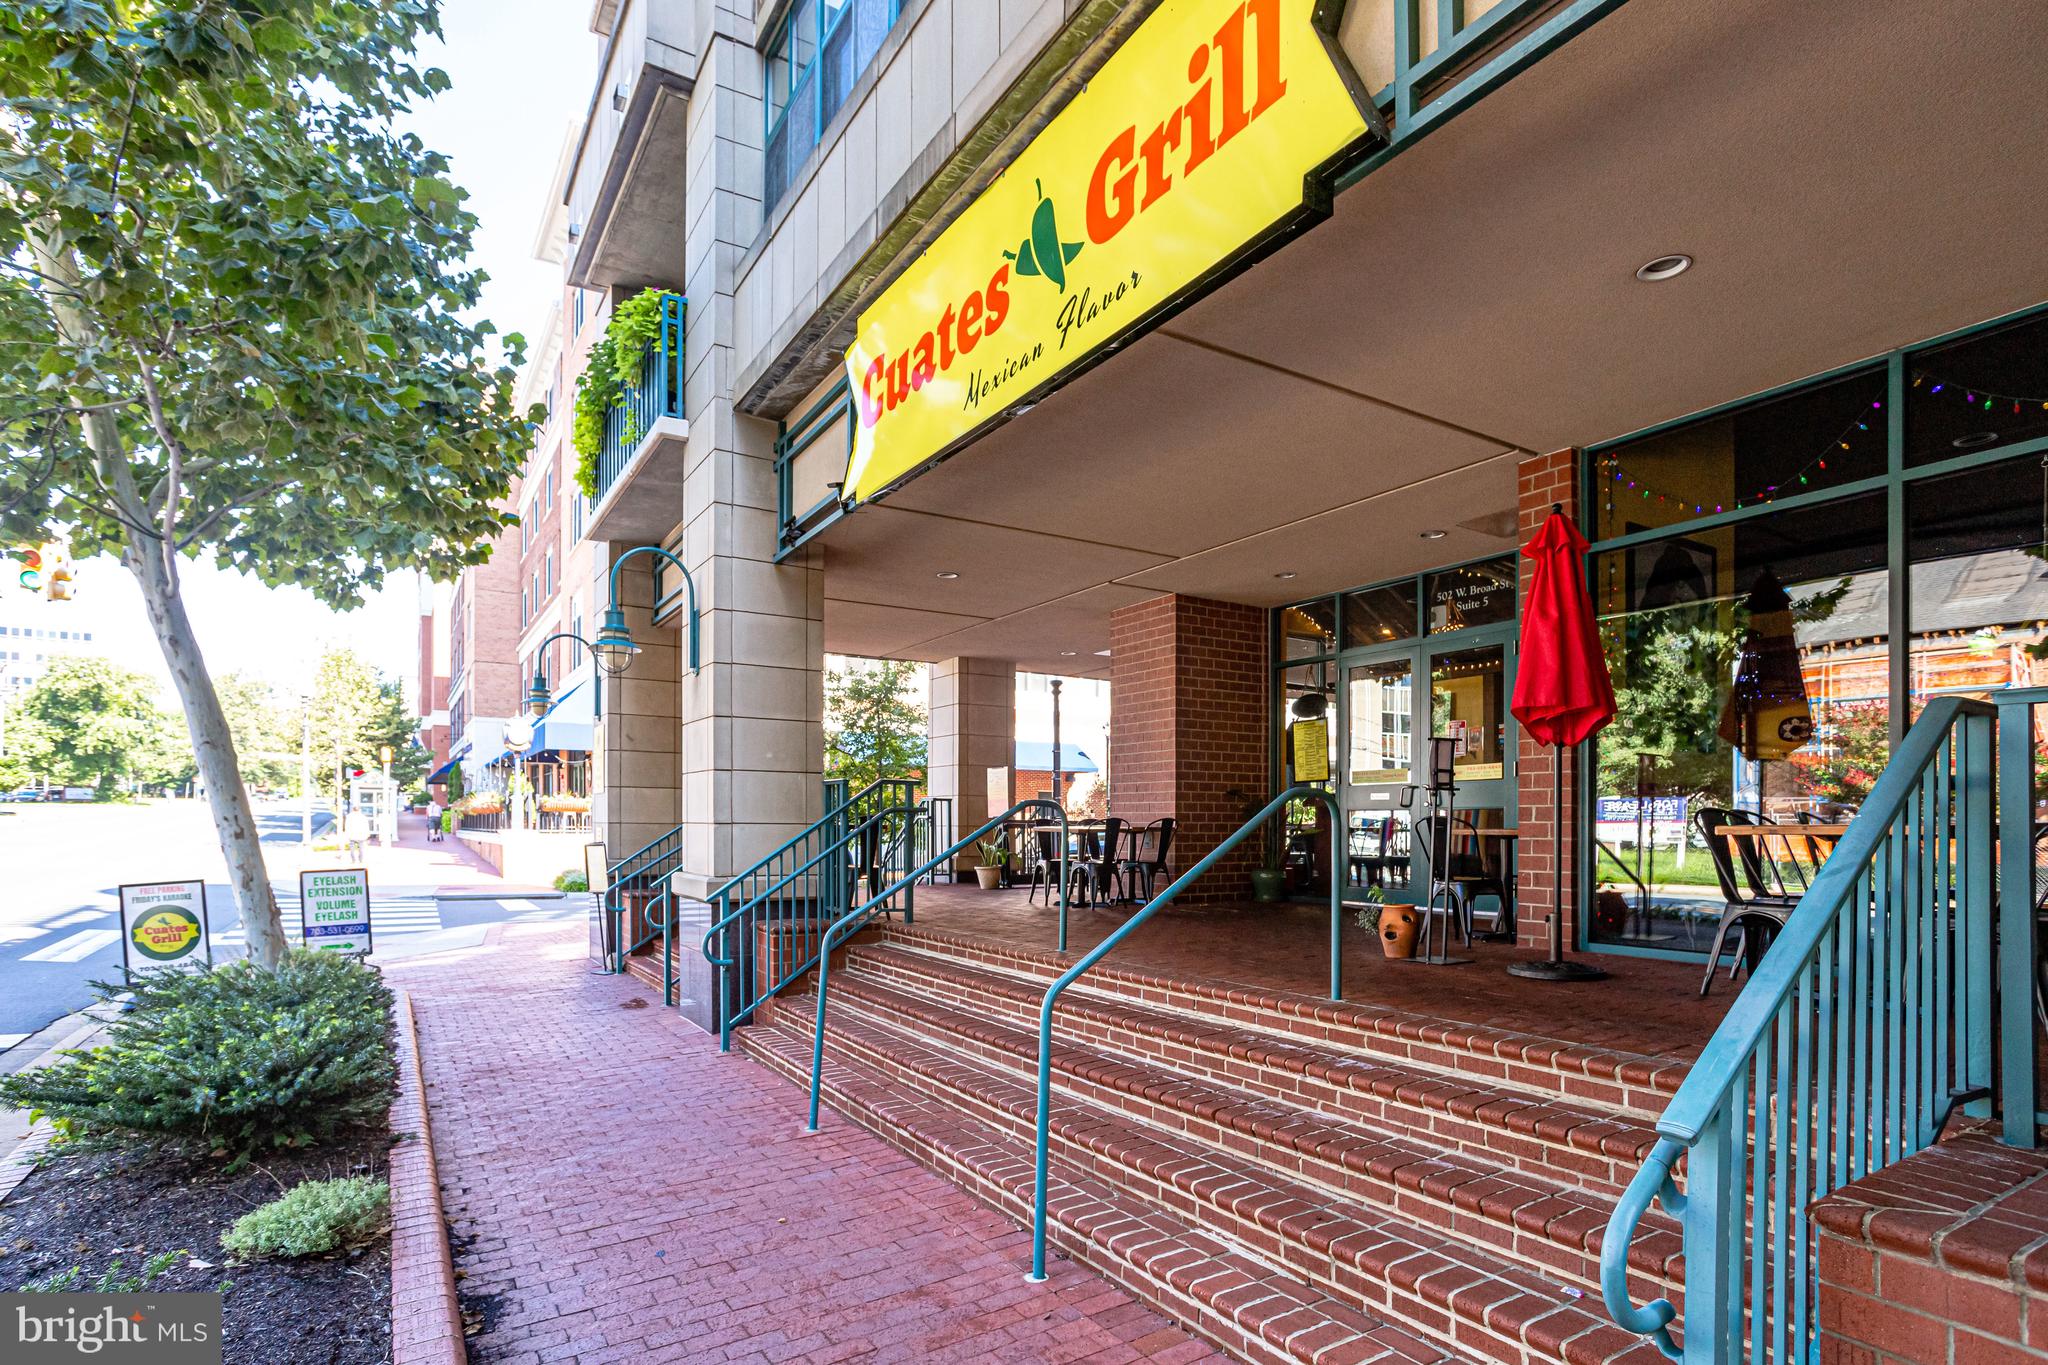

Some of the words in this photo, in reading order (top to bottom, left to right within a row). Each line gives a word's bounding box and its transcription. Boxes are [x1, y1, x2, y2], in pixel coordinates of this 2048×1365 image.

[862, 264, 1010, 429] Cuates
[1086, 0, 1288, 245] Grill
[964, 342, 1045, 412] Mexican
[1056, 270, 1143, 351] Flavor
[1436, 590, 1453, 602] 502
[1456, 588, 1467, 598] W.
[1470, 582, 1497, 595] Broad
[1456, 600, 1480, 611] Suite
[1482, 596, 1489, 607] 5
[313, 876, 356, 886] EYELASH
[308, 886, 363, 898] EXTENSION
[316, 900, 356, 910] VOLUME
[315, 911, 358, 921] EYELASH
[144, 925, 188, 935] Cuates
[151, 933, 183, 944] Grill
